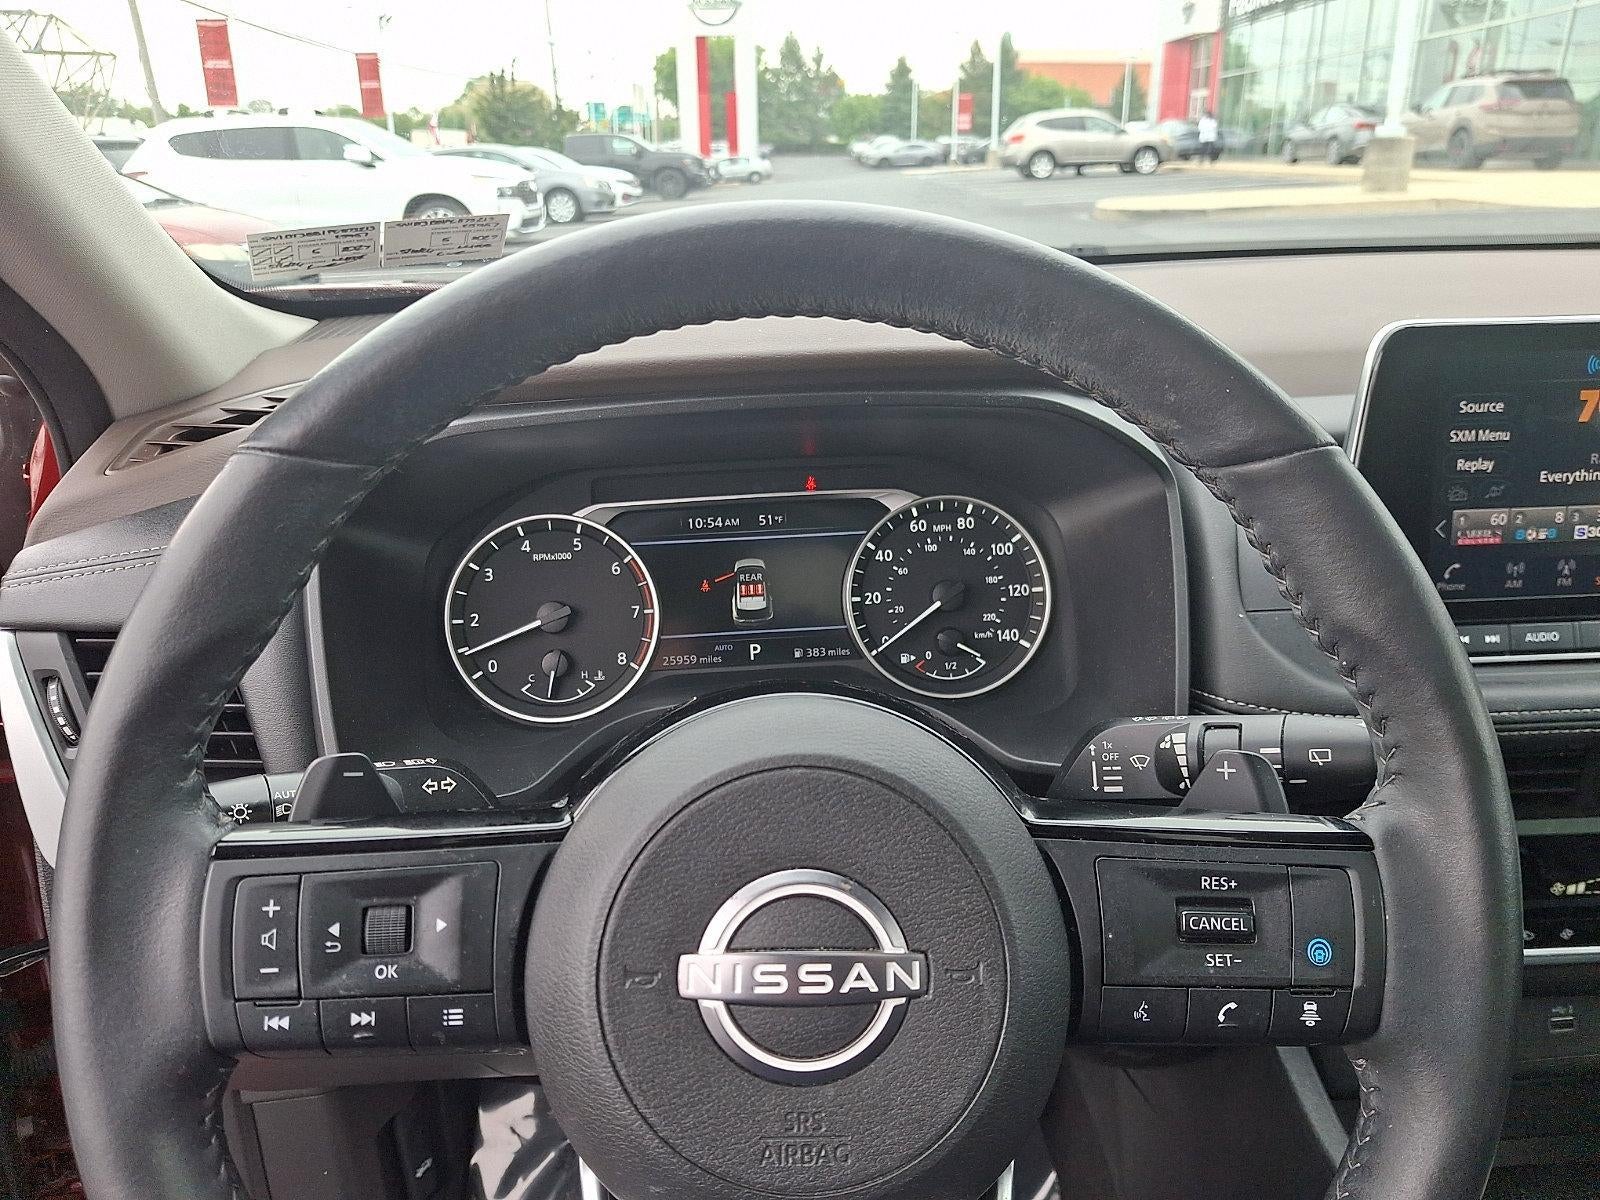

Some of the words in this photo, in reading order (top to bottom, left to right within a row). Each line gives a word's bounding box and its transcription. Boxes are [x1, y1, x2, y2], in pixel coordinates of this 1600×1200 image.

[1459, 400, 1505, 414] Source
[1578, 389, 1600, 423] 7
[1450, 429, 1476, 442] SXM
[1478, 428, 1511, 442] Menu
[1456, 457, 1495, 474] Replay
[688, 517, 723, 530] 10:54
[724, 518, 740, 526] AM
[1490, 512, 1508, 526] 60
[1515, 515, 1522, 524] 2
[1554, 512, 1564, 524] 8
[910, 520, 927, 532] 60
[932, 524, 952, 533] MPH
[957, 517, 974, 530] 80
[521, 540, 531, 552] 4
[573, 538, 582, 551] 5
[924, 544, 938, 552] 100
[963, 548, 976, 556] 140
[990, 542, 1014, 556] 100
[532, 552, 572, 562] RPMx1000
[874, 549, 892, 562] 40
[484, 568, 494, 582] 3
[612, 562, 620, 575] 6
[898, 567, 908, 576] 60
[740, 573, 763, 582] REAR
[985, 576, 998, 584] 180
[1008, 584, 1030, 597] 120
[864, 592, 882, 604] 20
[631, 606, 640, 618] 7
[894, 606, 904, 614] 20
[470, 614, 480, 627] 2
[982, 614, 996, 622] 220
[974, 630, 993, 639] km/h
[997, 628, 1020, 642] 140
[1524, 630, 1560, 642] AUDIO
[750, 643, 762, 661] P
[806, 648, 826, 658] 383
[828, 647, 850, 656] miles
[617, 652, 627, 666] 8
[662, 656, 698, 666] 25959
[700, 655, 722, 664] miles
[488, 660, 498, 673] 0
[944, 662, 957, 670] 1/2
[528, 674, 536, 682] C
[581, 671, 588, 679] H
[1102, 740, 1112, 750] 1x
[1102, 752, 1120, 762] OFF
[274, 790, 297, 800] AUT
[1200, 876, 1238, 890] RES+
[1188, 916, 1248, 932] CANCEL
[374, 964, 399, 978] OK
[685, 960, 921, 994] NISSAN
[784, 1112, 826, 1132] SRS
[760, 1144, 852, 1166] AIRBAG
